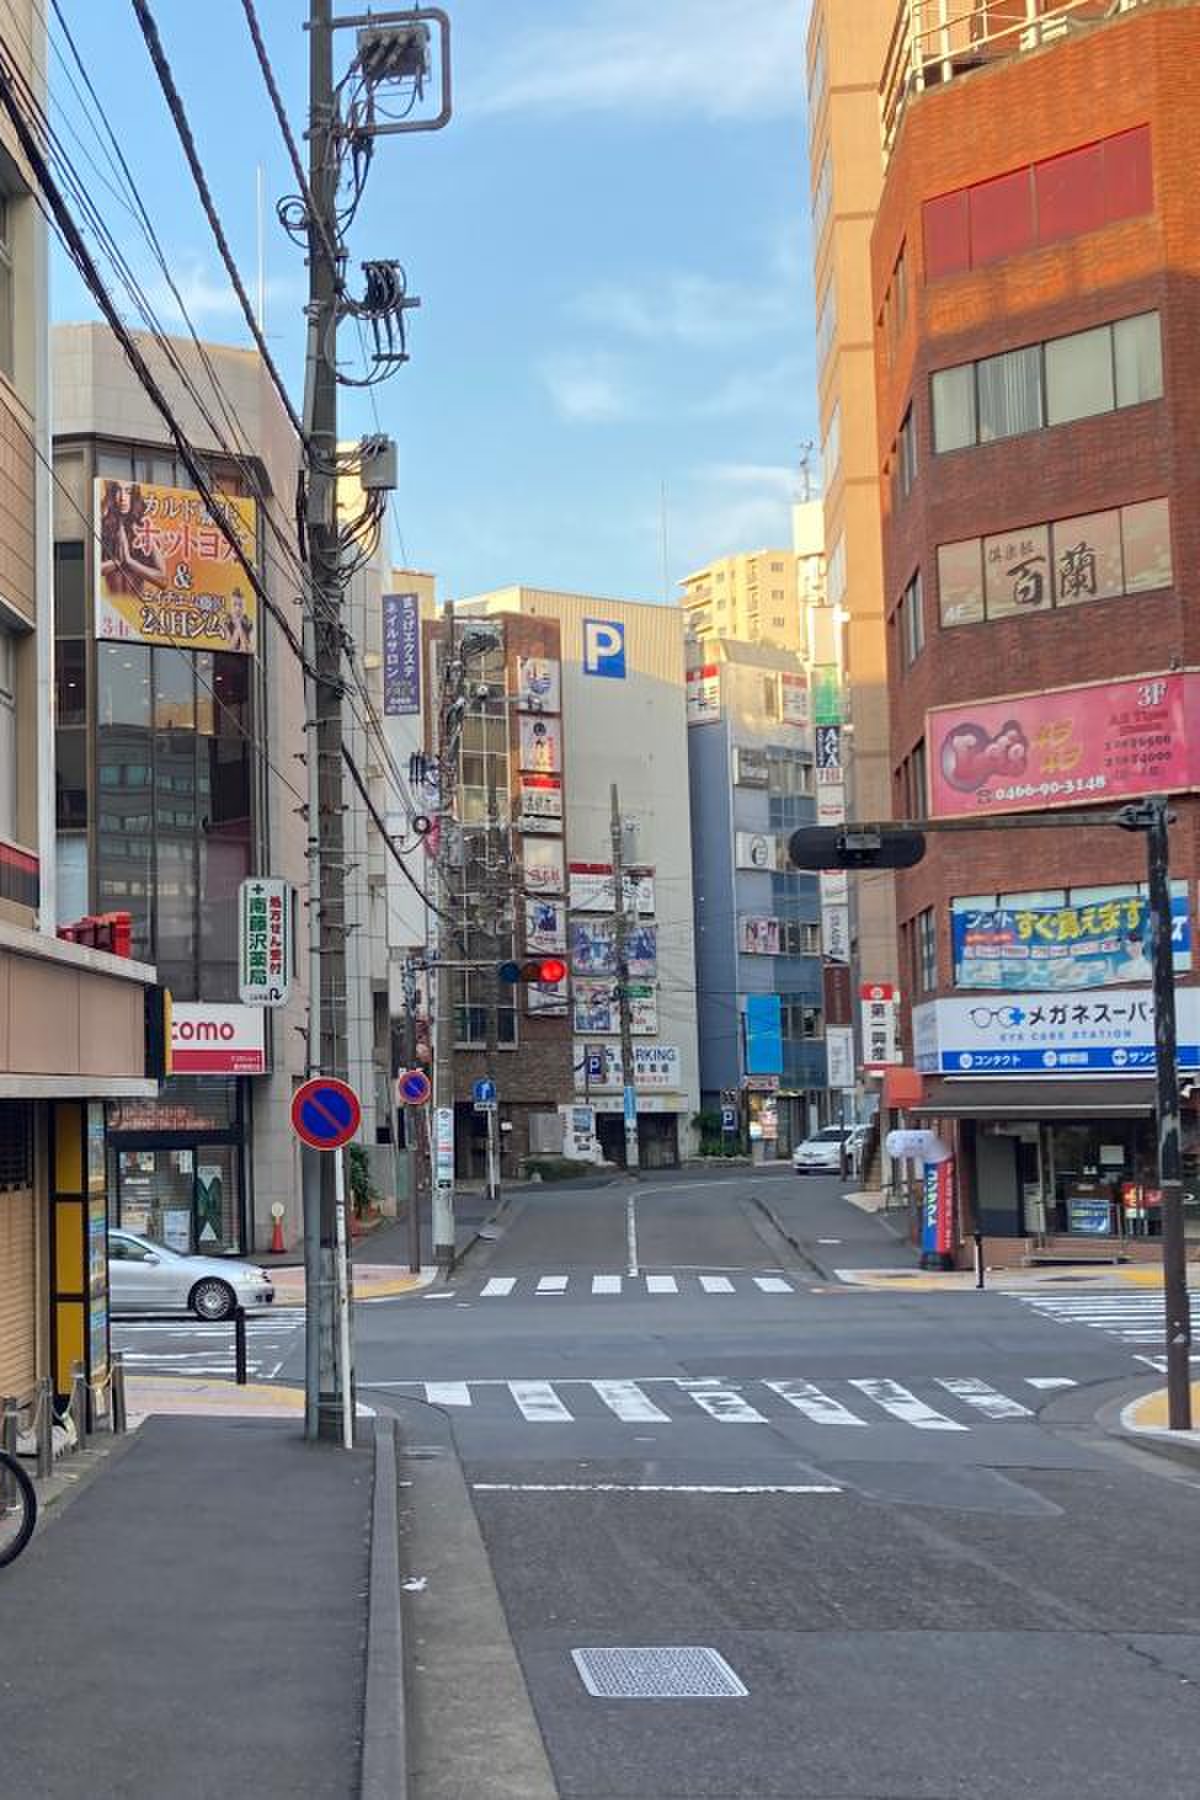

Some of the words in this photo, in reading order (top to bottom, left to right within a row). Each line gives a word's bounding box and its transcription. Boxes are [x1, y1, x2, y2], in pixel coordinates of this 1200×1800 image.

[174, 562, 194, 590] &
[586, 623, 622, 672] P
[825, 728, 839, 768] AGA
[1015, 899, 1145, 941] すぐ買えます
[249, 897, 267, 985] 南藤沢薬局
[1029, 1001, 1157, 1026] メガネスーパ
[1031, 1031, 1065, 1041] CARE
[1072, 1029, 1133, 1040] STATION
[974, 1053, 1021, 1067] コンタクト
